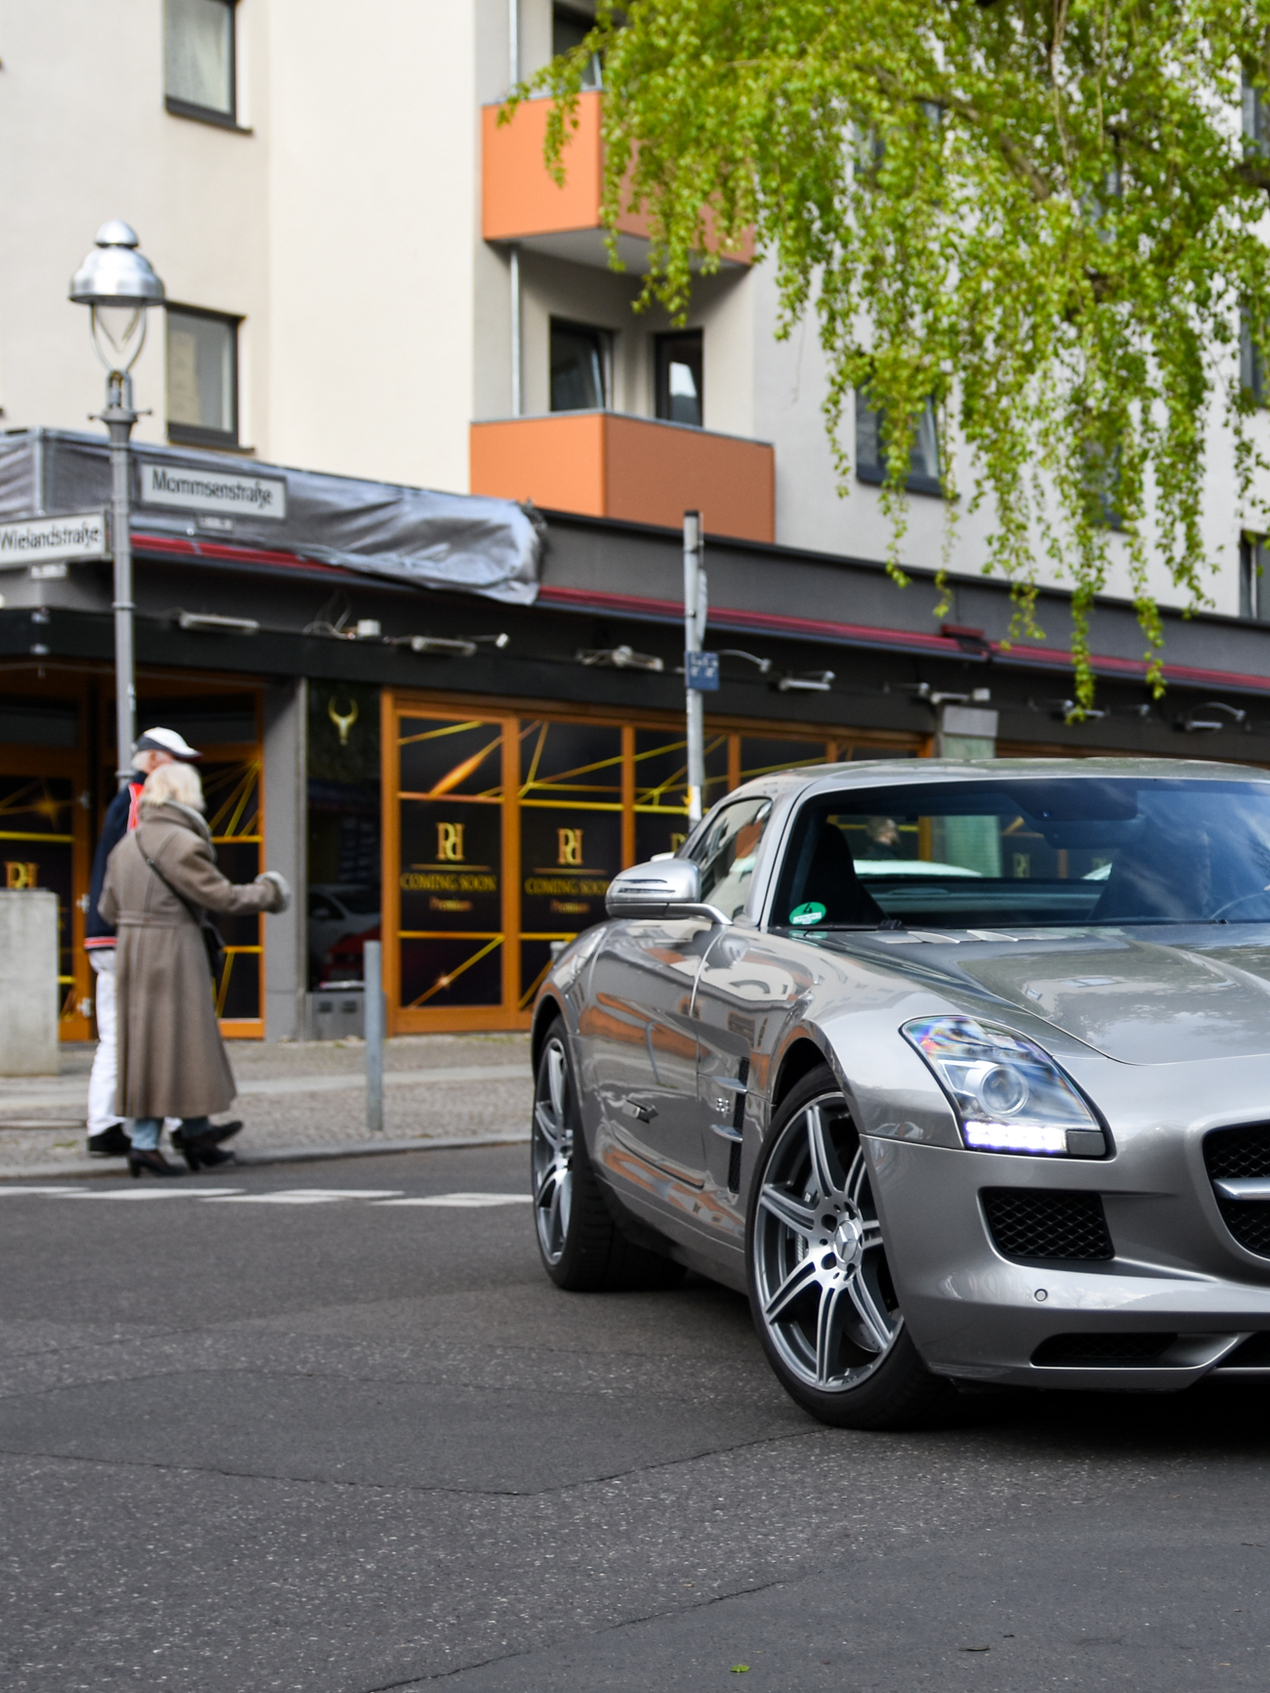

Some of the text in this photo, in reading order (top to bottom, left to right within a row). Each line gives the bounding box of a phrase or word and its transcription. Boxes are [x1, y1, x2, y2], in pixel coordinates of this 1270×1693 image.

[152, 469, 273, 508] Mommsenstraße
[401, 873, 497, 892] COMING SOON
[524, 878, 577, 896] COMING
[802, 902, 813, 914] 4
